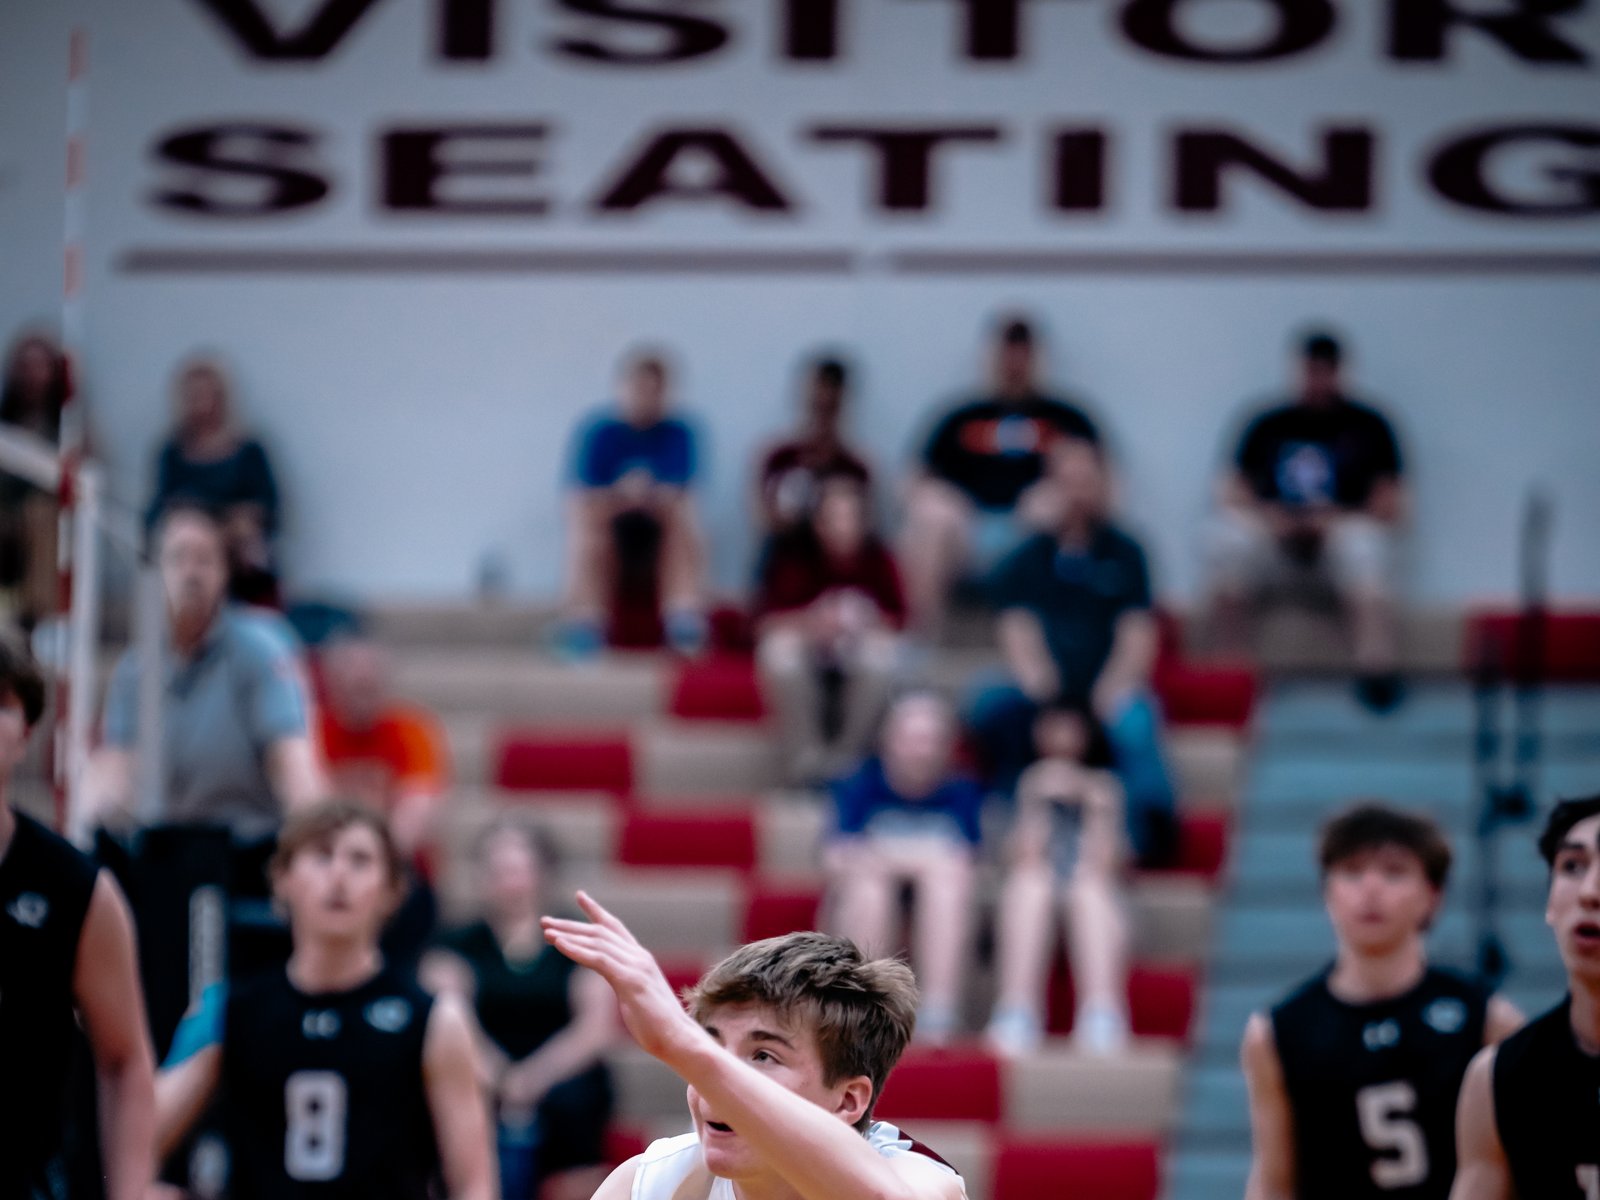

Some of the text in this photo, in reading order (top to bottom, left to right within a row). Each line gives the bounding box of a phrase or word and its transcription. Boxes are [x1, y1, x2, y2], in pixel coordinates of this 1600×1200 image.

[200, 0, 1591, 63] VISITOR
[148, 124, 1600, 215] SEATING
[284, 1068, 347, 1181] 8
[1357, 1080, 1428, 1189] 5
